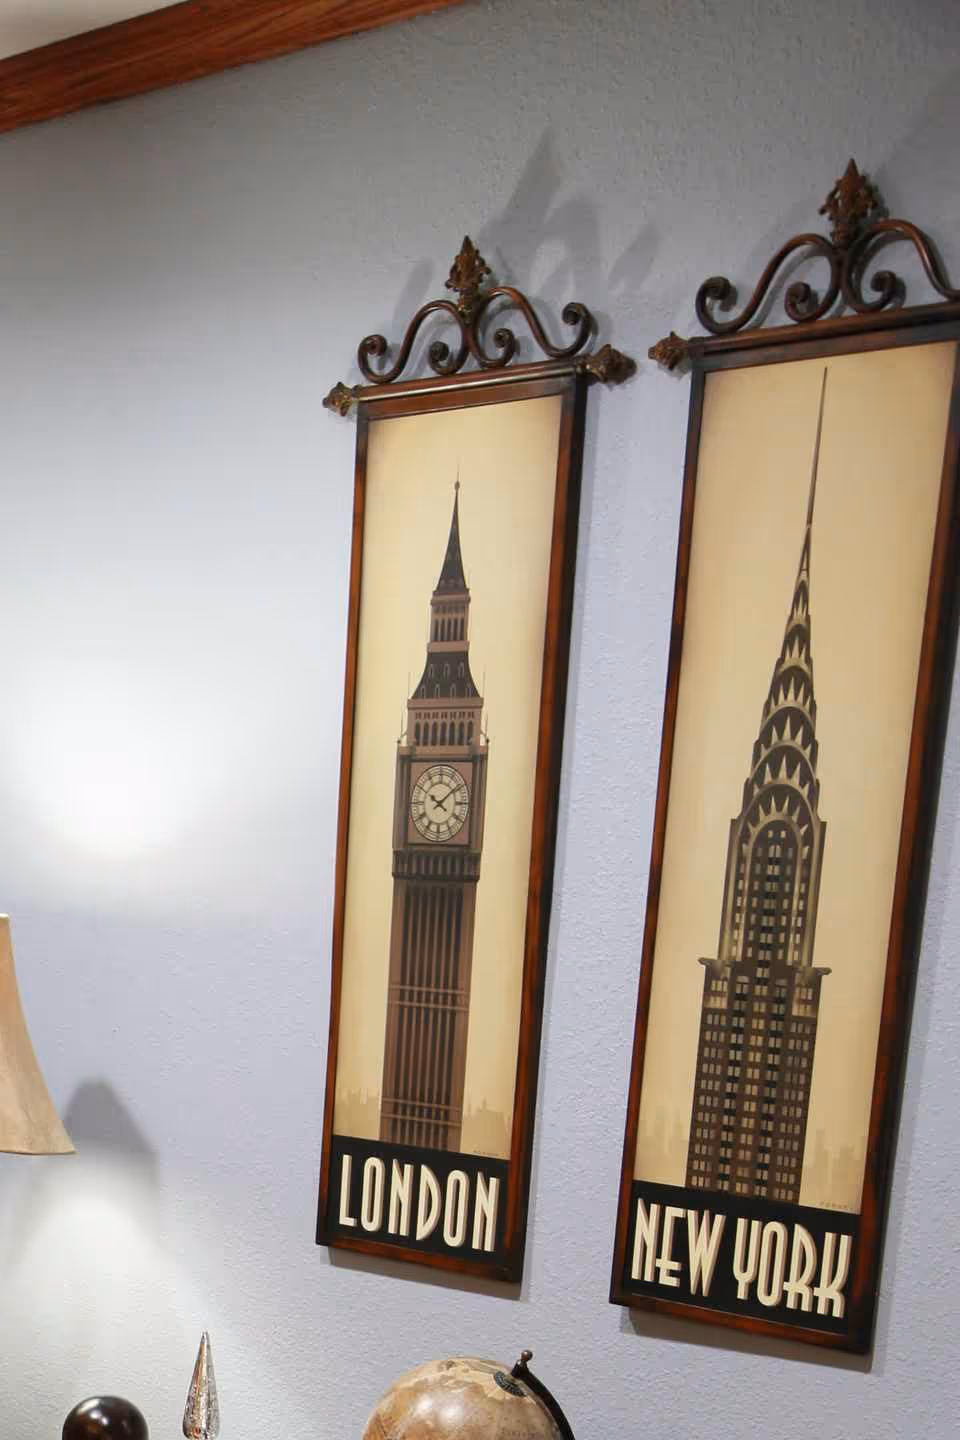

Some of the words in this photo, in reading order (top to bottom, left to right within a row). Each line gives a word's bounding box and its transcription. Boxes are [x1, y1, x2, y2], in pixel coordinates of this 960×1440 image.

[338, 1153, 499, 1253] LONDON
[631, 1196, 725, 1297] NEW
[732, 1217, 854, 1319] YORK
